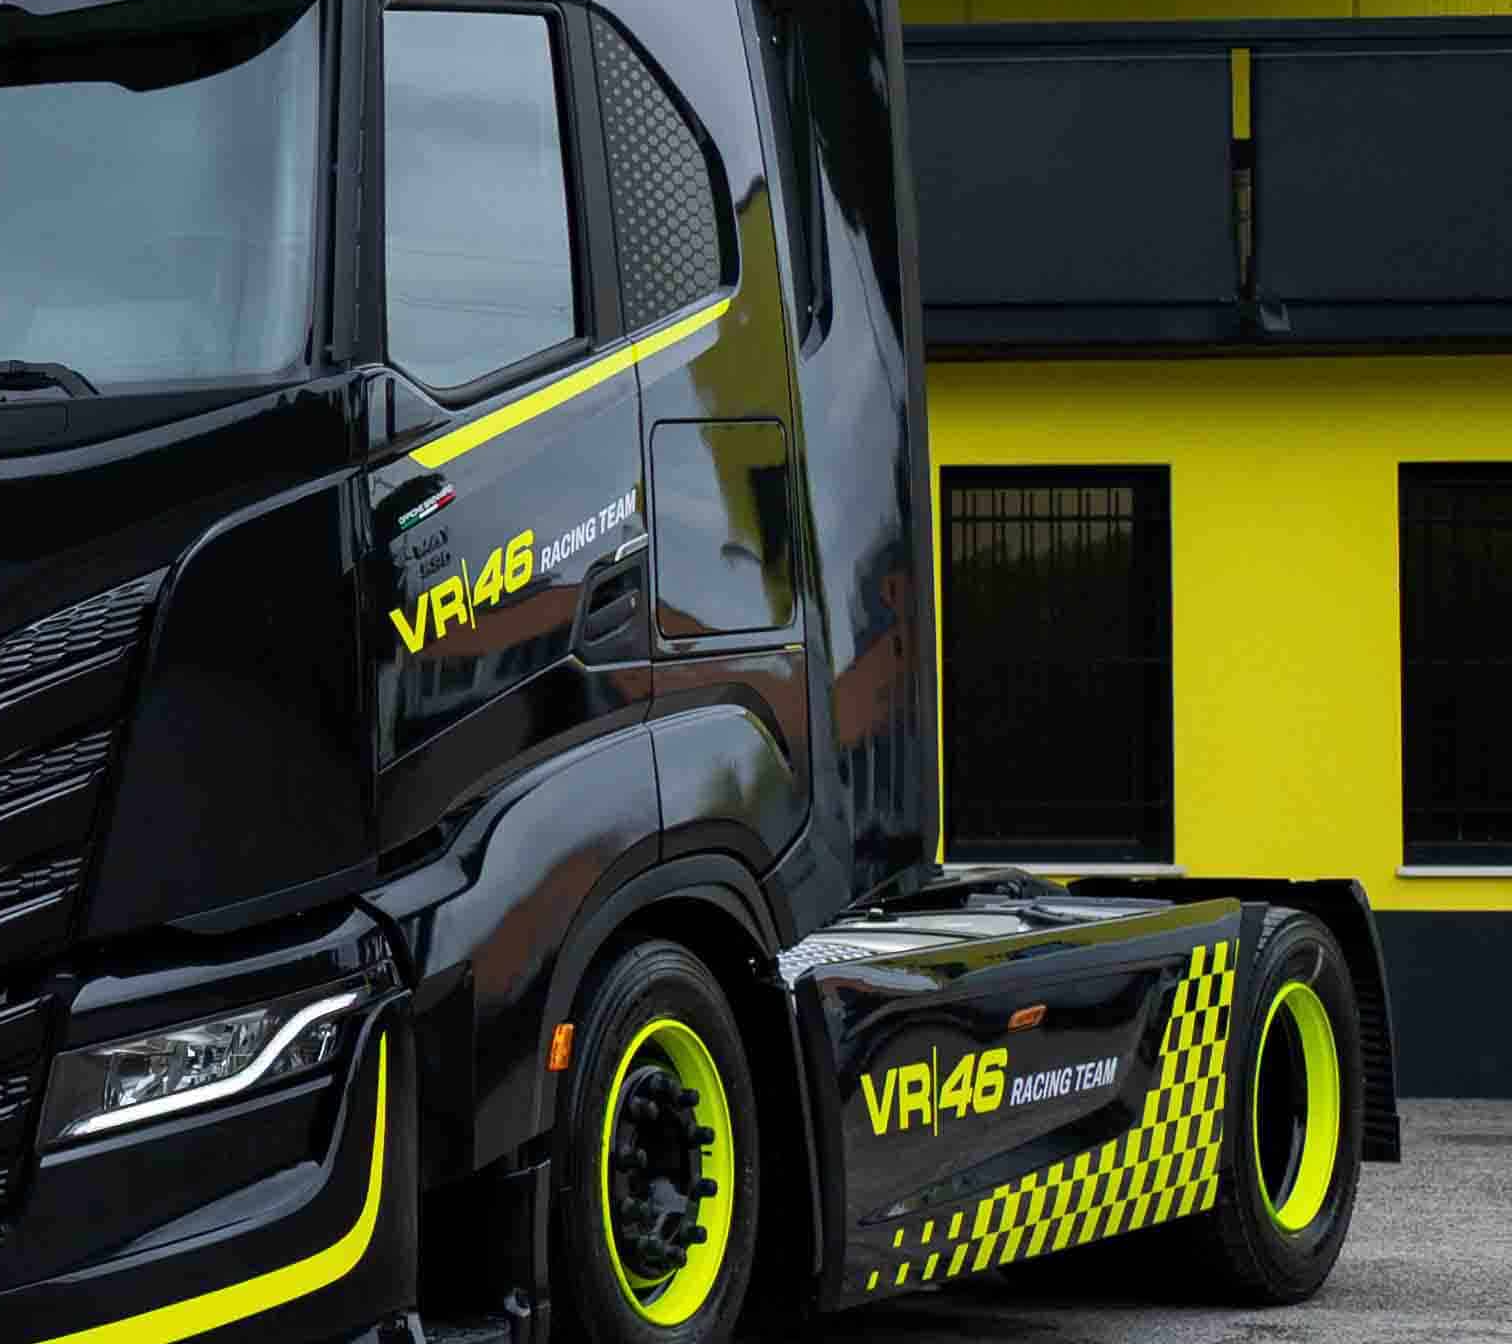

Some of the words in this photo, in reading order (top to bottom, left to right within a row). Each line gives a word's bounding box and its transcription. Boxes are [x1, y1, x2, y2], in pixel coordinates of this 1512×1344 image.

[540, 518, 596, 573] RACING
[598, 489, 637, 535] TEAM
[1010, 1070, 1071, 1106] RACING
[1074, 1057, 1119, 1091] TEAM
